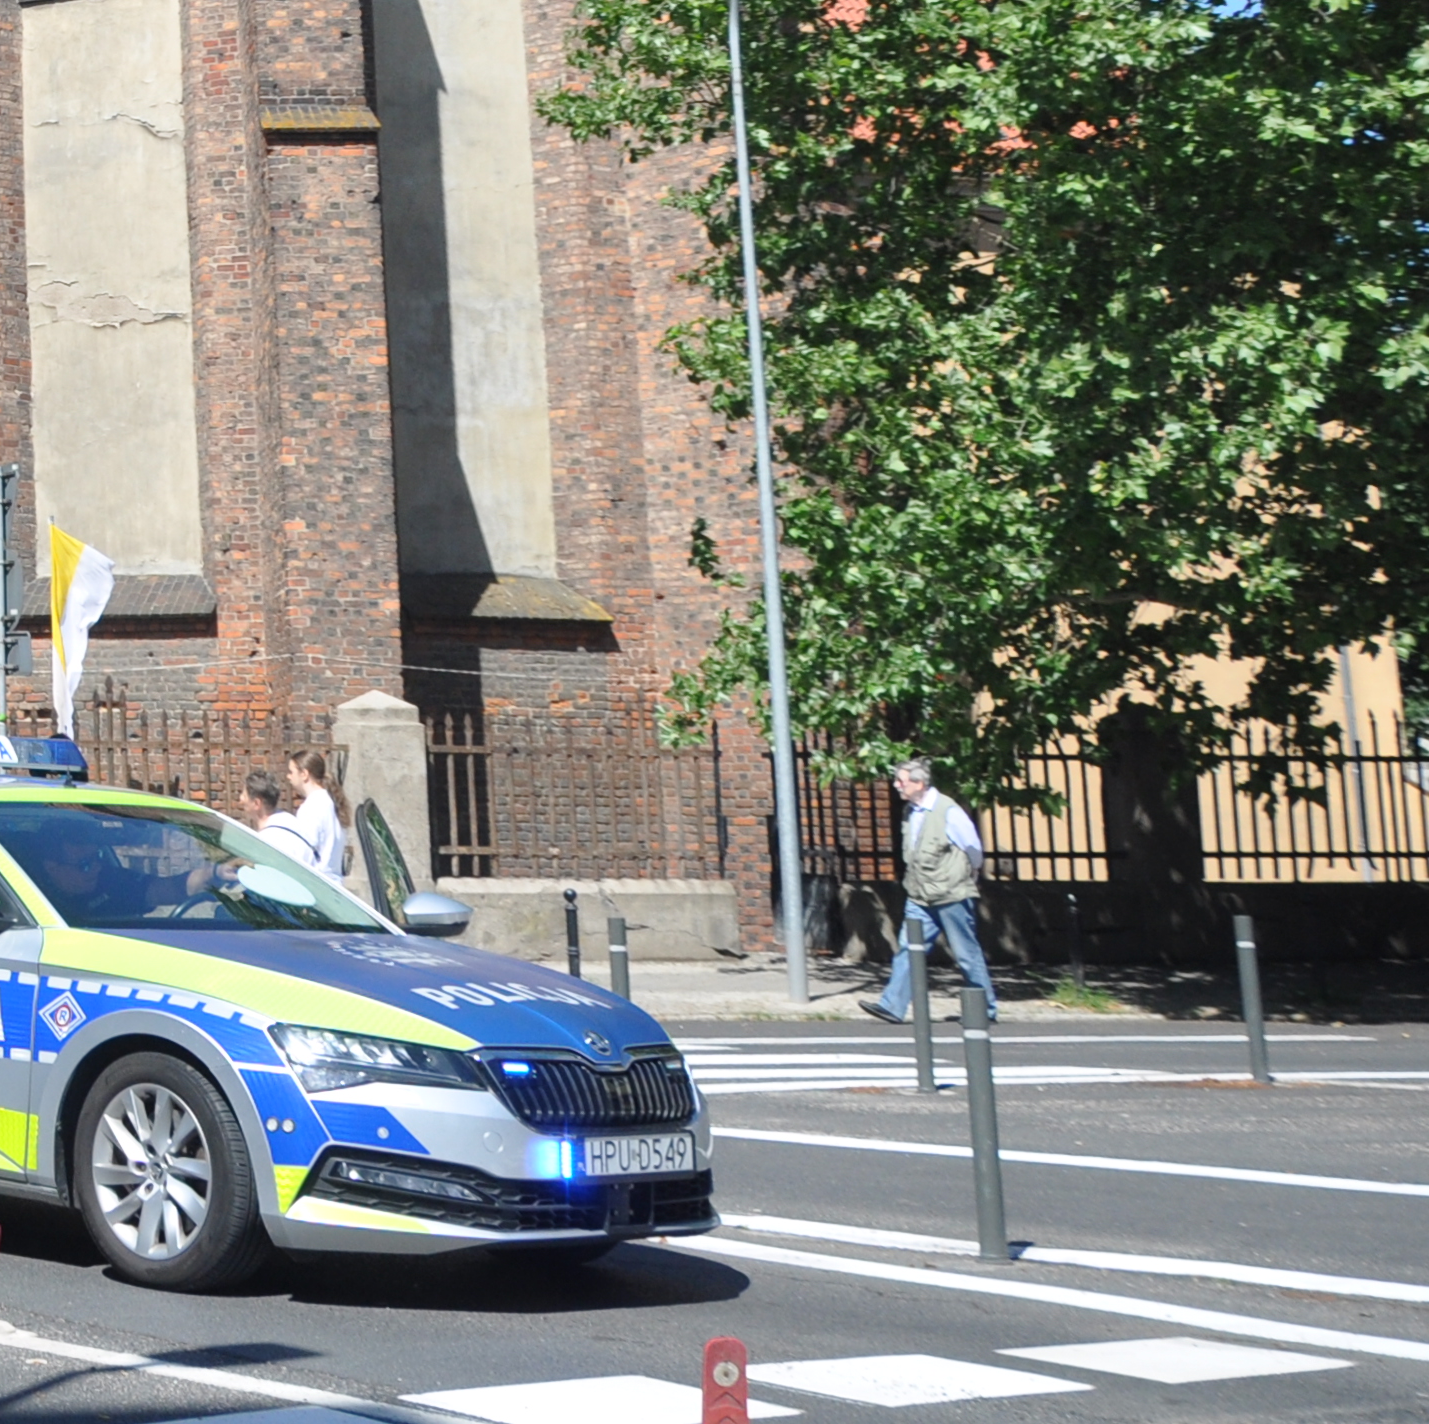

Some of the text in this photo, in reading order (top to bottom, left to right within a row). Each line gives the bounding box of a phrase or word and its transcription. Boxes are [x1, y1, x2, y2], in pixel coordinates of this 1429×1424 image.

[409, 981, 613, 1010] POLICJA
[590, 1137, 687, 1173] HPU D549
